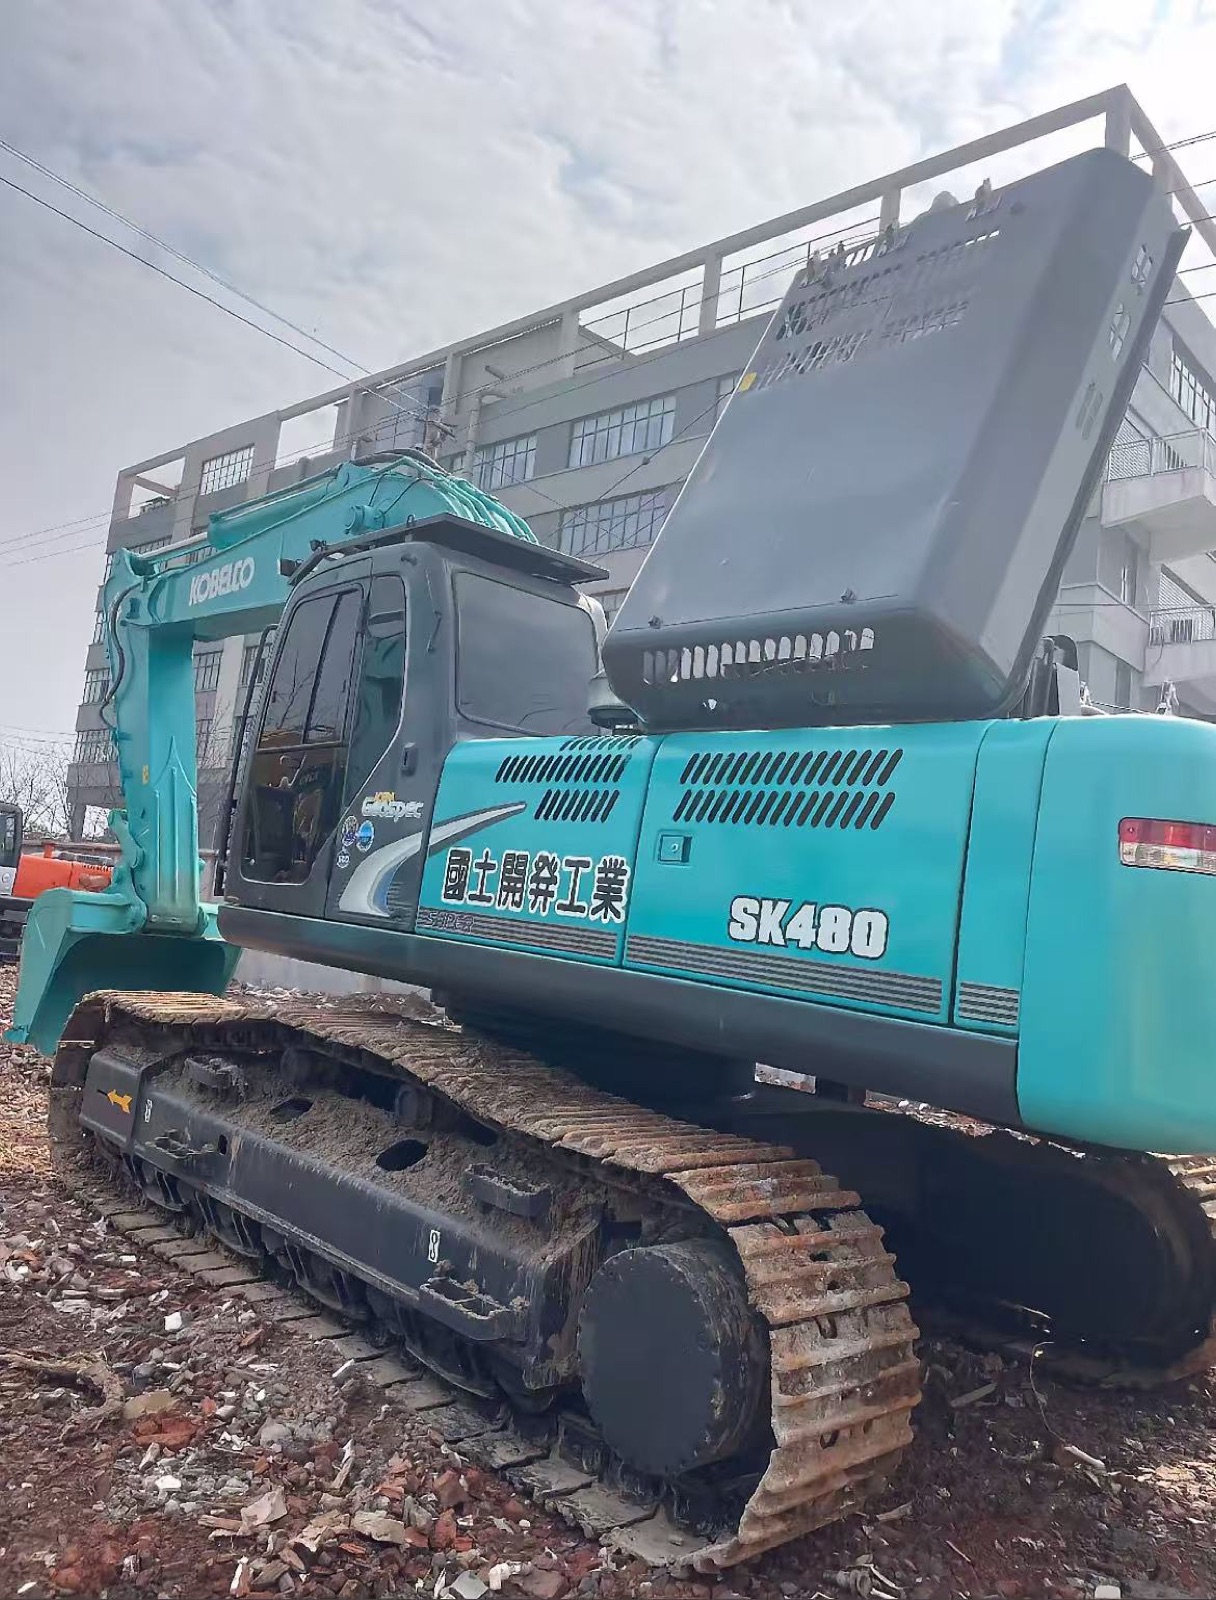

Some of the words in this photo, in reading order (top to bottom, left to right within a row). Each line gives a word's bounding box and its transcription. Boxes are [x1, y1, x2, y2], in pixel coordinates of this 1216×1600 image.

[189, 557, 255, 607] KOBELCO
[442, 848, 631, 923] 國土開発工業
[728, 895, 889, 959] SK480
